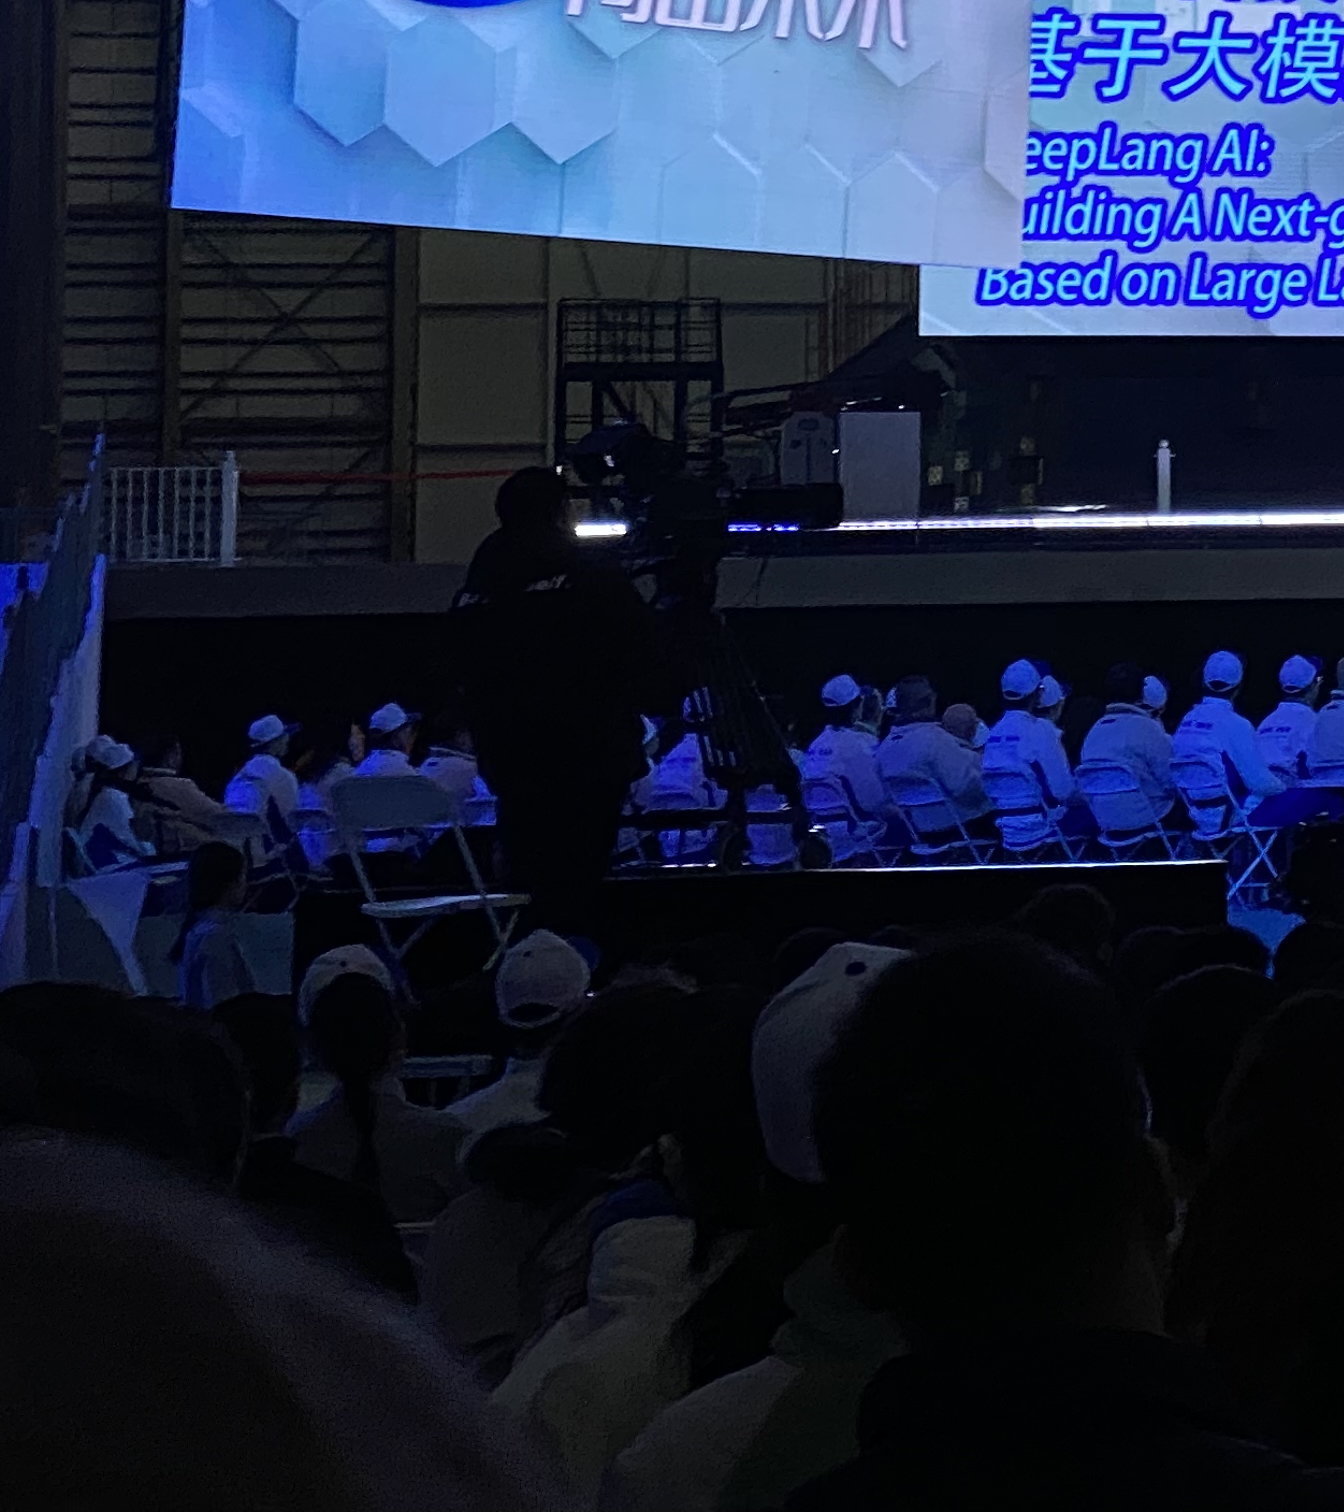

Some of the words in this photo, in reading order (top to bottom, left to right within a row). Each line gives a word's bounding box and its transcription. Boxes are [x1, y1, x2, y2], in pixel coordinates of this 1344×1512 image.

[1027, 127, 1204, 183] eepLang
[1213, 129, 1269, 173] AI:
[1023, 189, 1165, 248] uilding
[1171, 192, 1203, 236] A
[981, 254, 1115, 302] Based
[1120, 267, 1178, 302] on
[1189, 256, 1306, 314] Large
